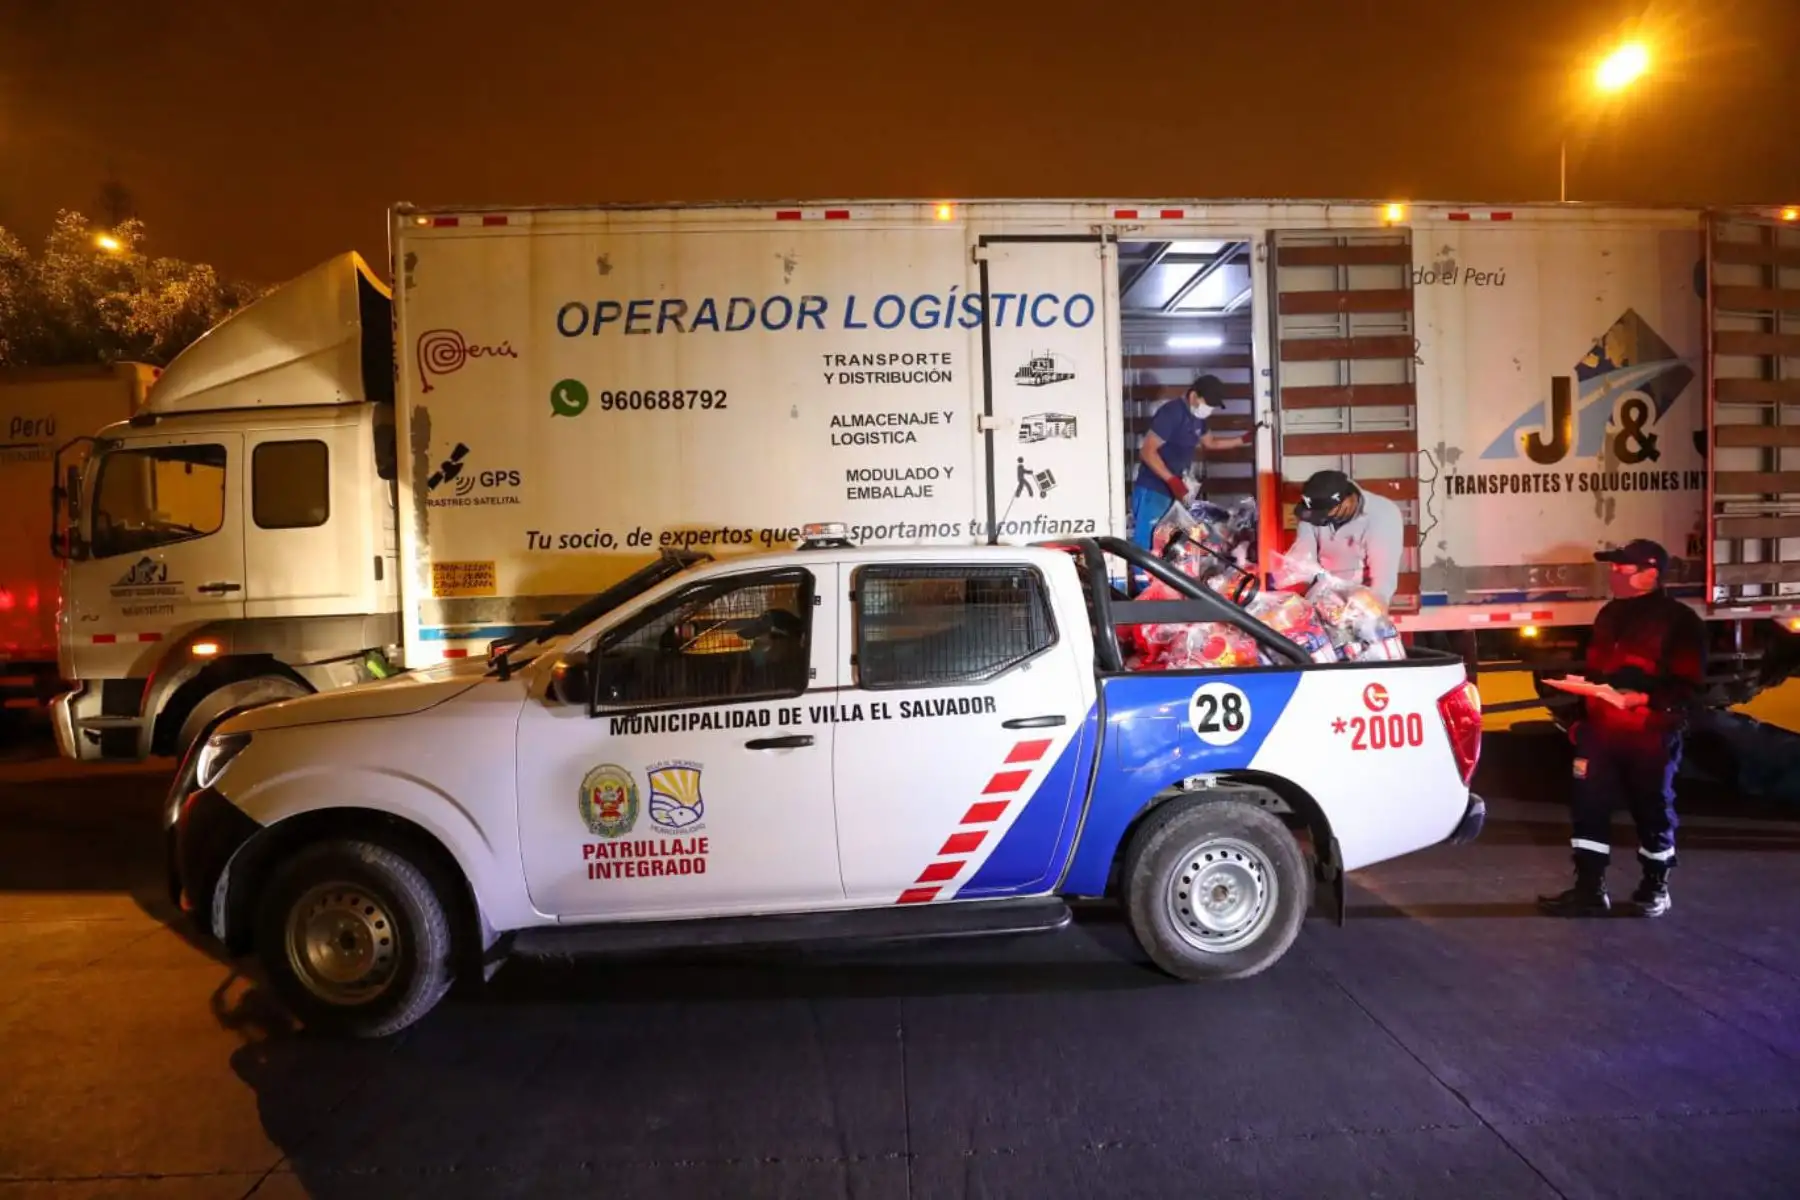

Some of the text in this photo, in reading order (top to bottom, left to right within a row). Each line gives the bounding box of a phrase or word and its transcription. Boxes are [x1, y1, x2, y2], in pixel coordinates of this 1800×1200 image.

[1412, 264, 1507, 286] do el Perú
[556, 285, 1095, 338] OPERADOR LOGÍSTICO
[822, 352, 952, 367] TRANSPORTE
[824, 368, 952, 384] Y DISTRIBUCIÓN
[600, 390, 728, 411] 960688792
[830, 411, 954, 428] ALMACENAJE Y
[1522, 376, 1571, 465] J
[1613, 398, 1661, 464] &
[831, 433, 917, 446] LOGISTICA
[480, 470, 521, 487] GPS
[846, 466, 954, 482] MODULADO Y
[1445, 473, 1562, 495] TRANSPORTES
[1565, 472, 1577, 493] Y
[1578, 471, 1680, 494] SOLUCIONES
[473, 496, 521, 506] SATELITAL
[846, 485, 934, 501] EMBALAJE
[526, 514, 1096, 552] Tu socio, de expertos que sportamos tu confianza
[610, 696, 997, 736] MUNICIPALIDAD DE VILLA EL SALVADOR
[1195, 692, 1244, 733] 28
[582, 837, 710, 860] PATRULLAJE
[588, 857, 706, 881] INTEGRADO
